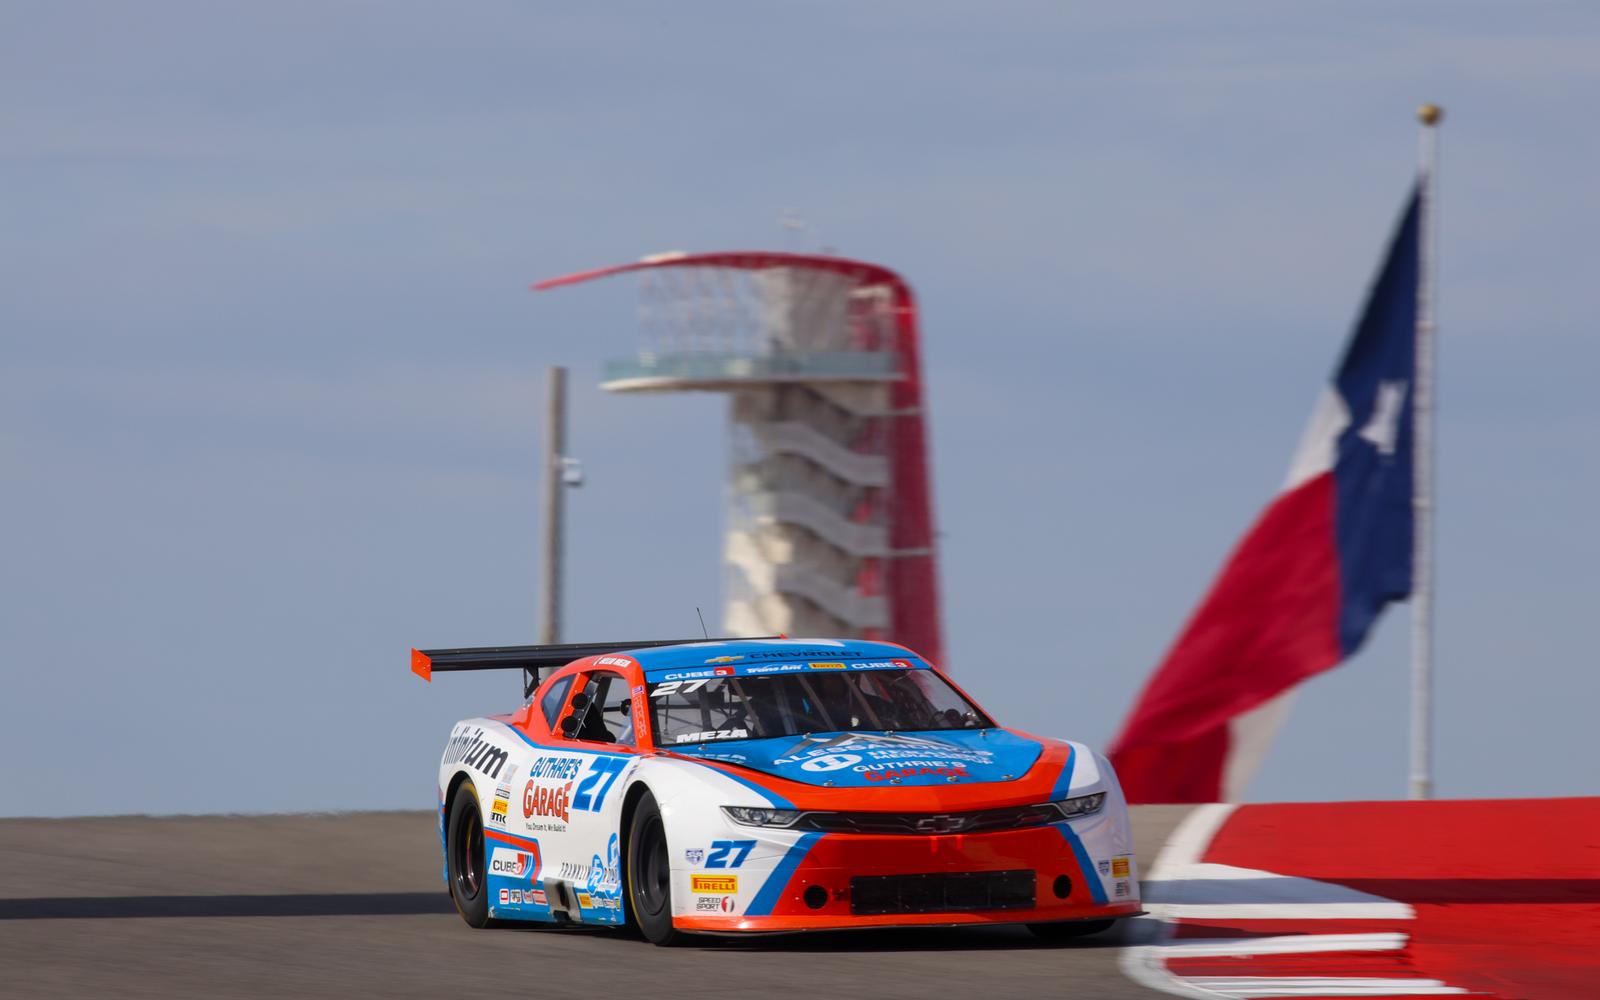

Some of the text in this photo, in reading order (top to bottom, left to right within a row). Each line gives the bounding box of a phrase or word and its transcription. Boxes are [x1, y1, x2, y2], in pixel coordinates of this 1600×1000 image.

[750, 651, 863, 660] CHEVROLET
[650, 678, 711, 698] 27
[676, 729, 748, 743] MEZA
[529, 756, 583, 780] GUTHRIE'S
[852, 760, 967, 773] GUTHRIE'S
[863, 767, 972, 783] GARAGE
[572, 756, 631, 813] 27
[522, 778, 574, 824] GARAGE
[703, 840, 758, 869] 27
[692, 877, 736, 891] PIRELLI
